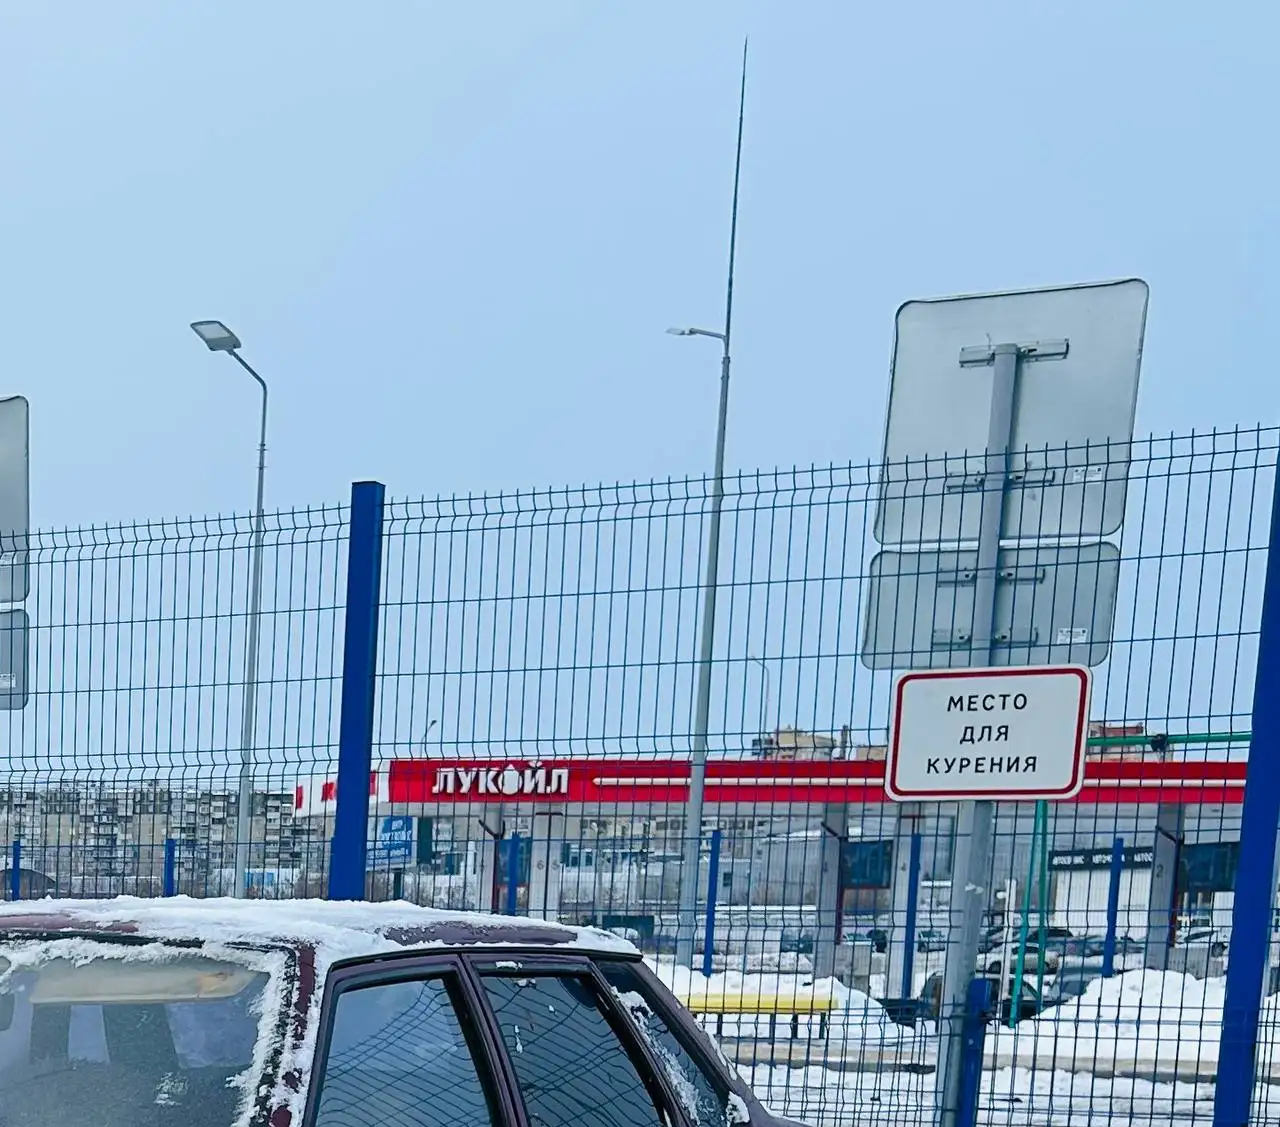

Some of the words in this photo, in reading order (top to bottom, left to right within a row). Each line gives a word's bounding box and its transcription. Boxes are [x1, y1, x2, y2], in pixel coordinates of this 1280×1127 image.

[947, 693, 1027, 712] МЕСТО
[959, 725, 1009, 745] ДЛЯ
[926, 756, 1037, 774] КУРЕНИЯ
[431, 760, 569, 796] ЛУКОЙЛ
